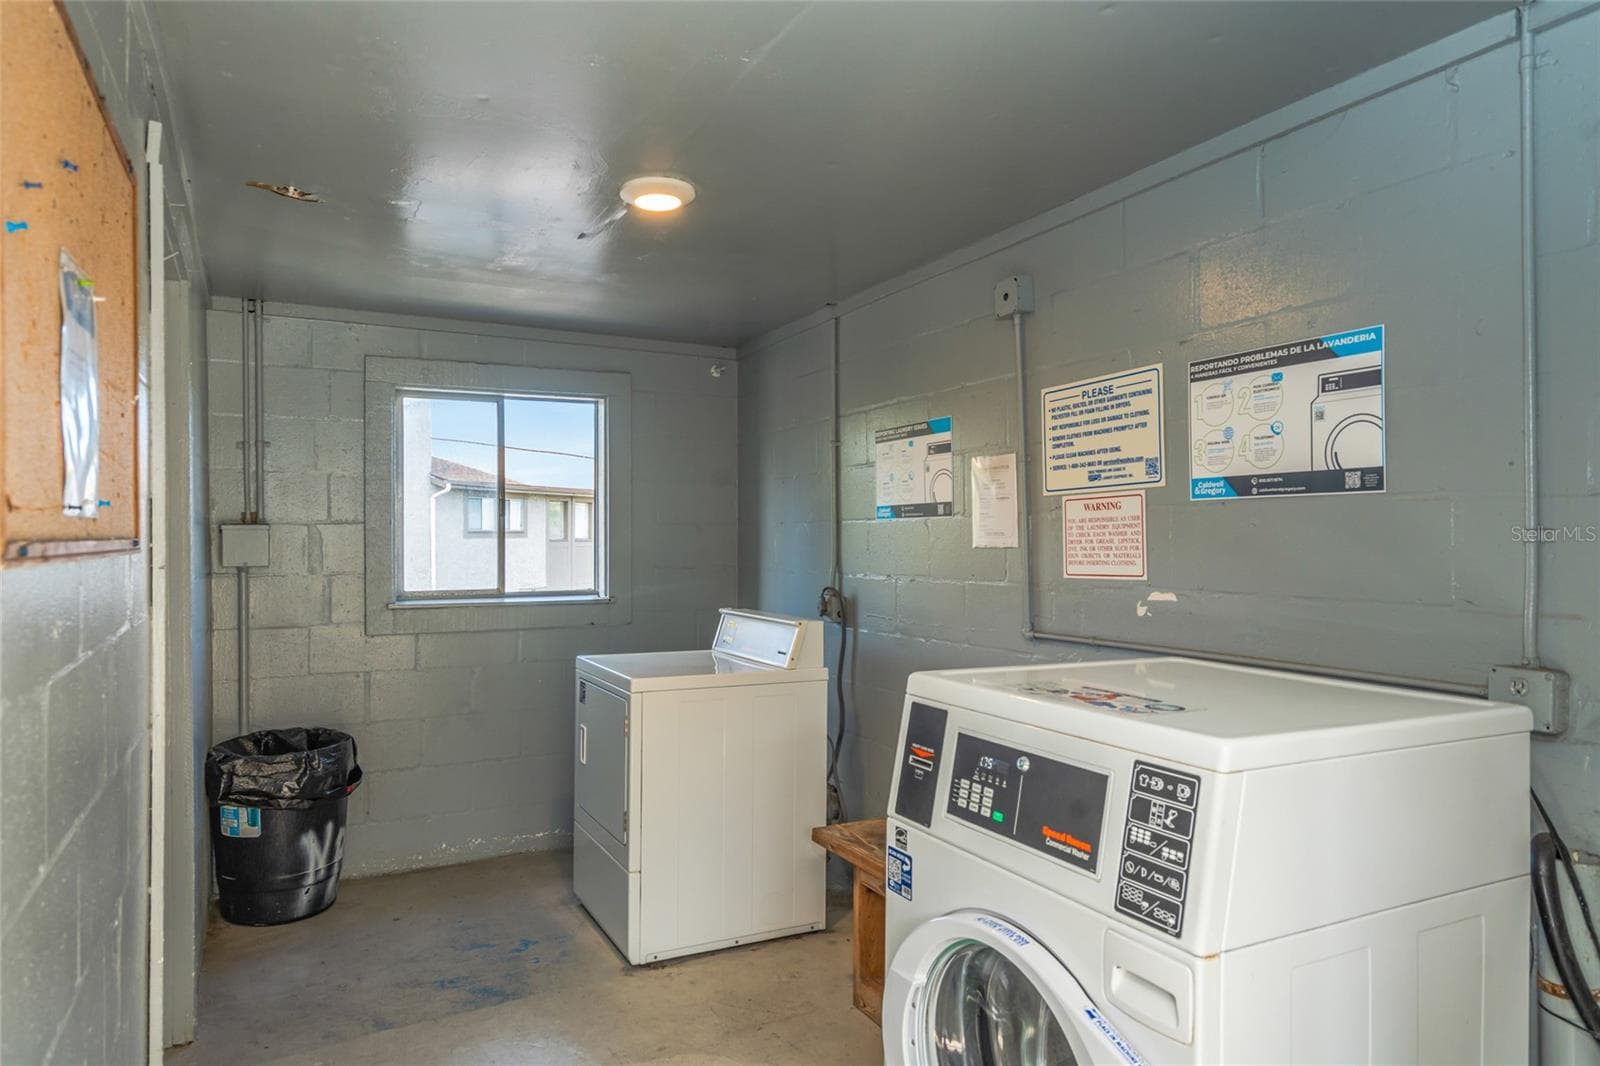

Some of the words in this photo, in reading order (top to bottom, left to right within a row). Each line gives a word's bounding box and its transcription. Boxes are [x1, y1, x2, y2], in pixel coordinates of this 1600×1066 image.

[1190, 358, 1239, 373] REPORTANDO
[1240, 348, 1288, 364] PROBLEMAS
[1290, 345, 1302, 355] DE
[1303, 343, 1316, 352] LA
[1317, 332, 1377, 350] LAVANDERIA
[1195, 370, 1218, 378] MANERAS
[1237, 359, 1278, 371] CONVENIENTES
[1081, 385, 1114, 400] PLEASE
[1197, 480, 1224, 488] Caldwell
[1083, 501, 1122, 512] WARNING
